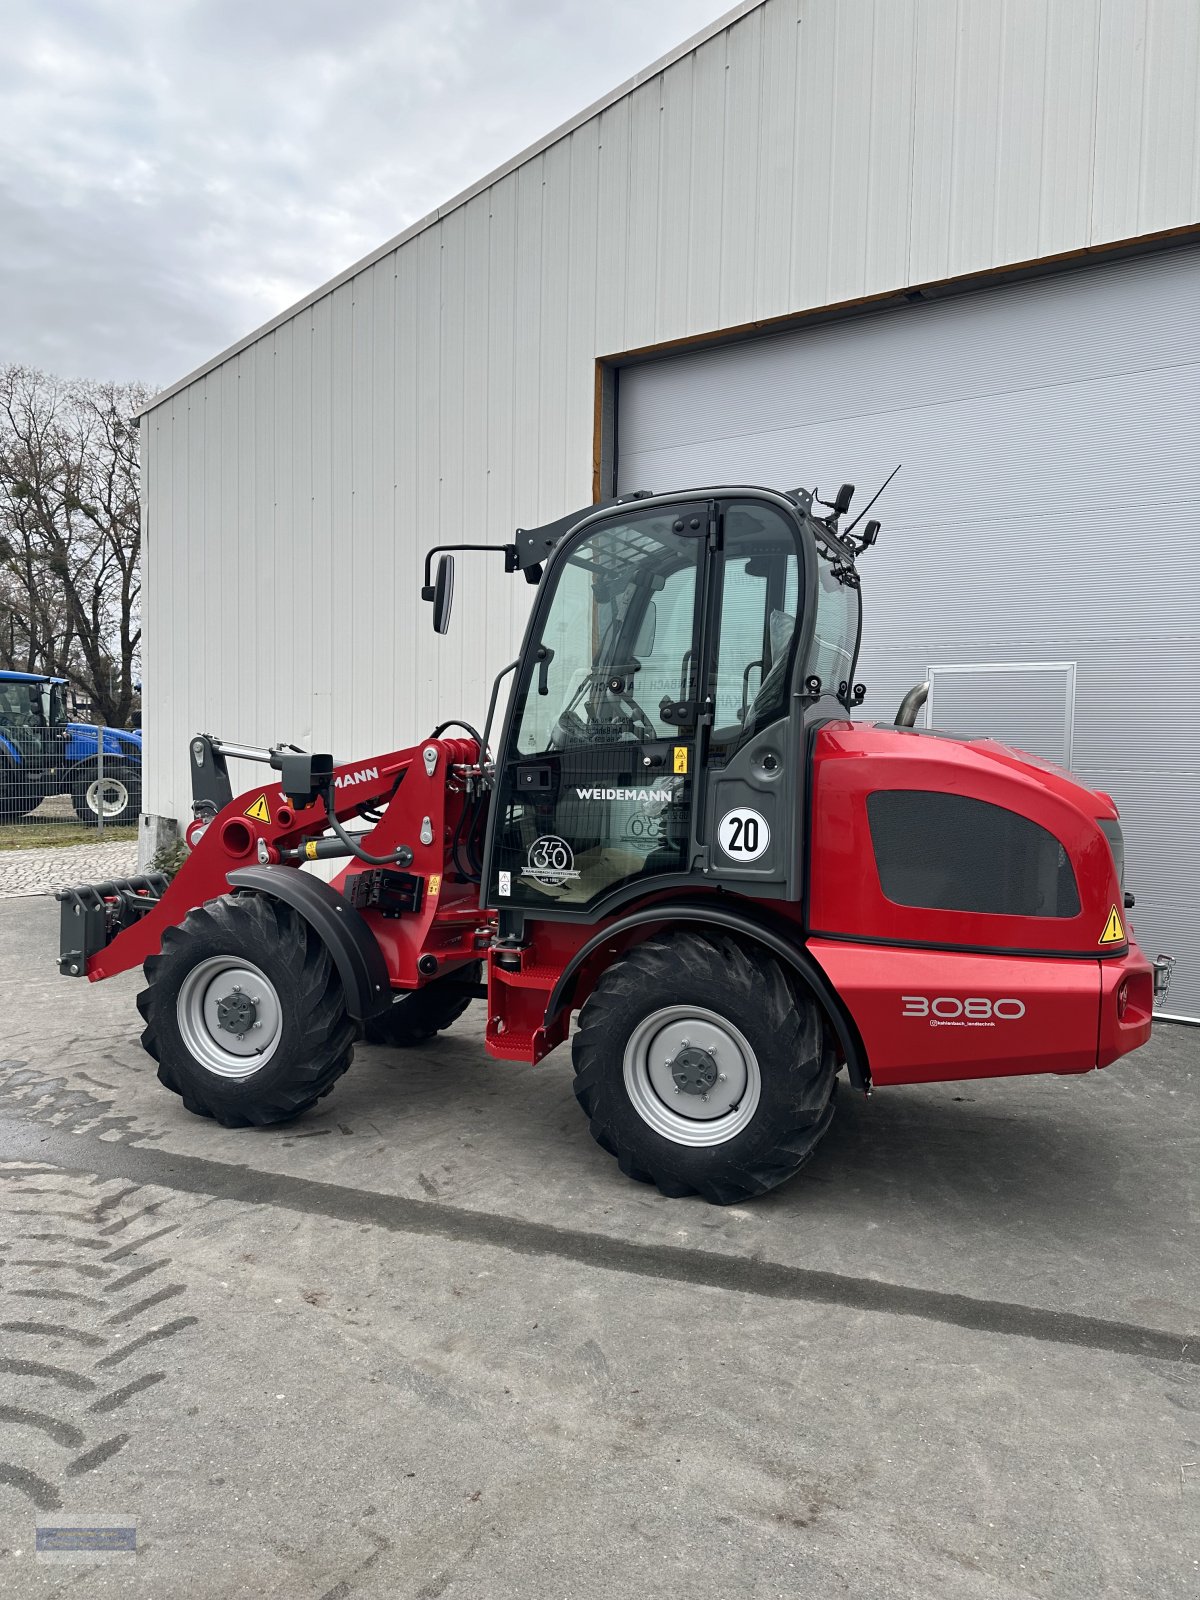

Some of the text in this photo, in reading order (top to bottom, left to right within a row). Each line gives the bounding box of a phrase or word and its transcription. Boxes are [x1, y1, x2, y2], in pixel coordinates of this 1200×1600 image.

[576, 788, 672, 802] WEIDEMANN
[728, 817, 759, 853] 20
[902, 996, 1026, 1019] 3080
